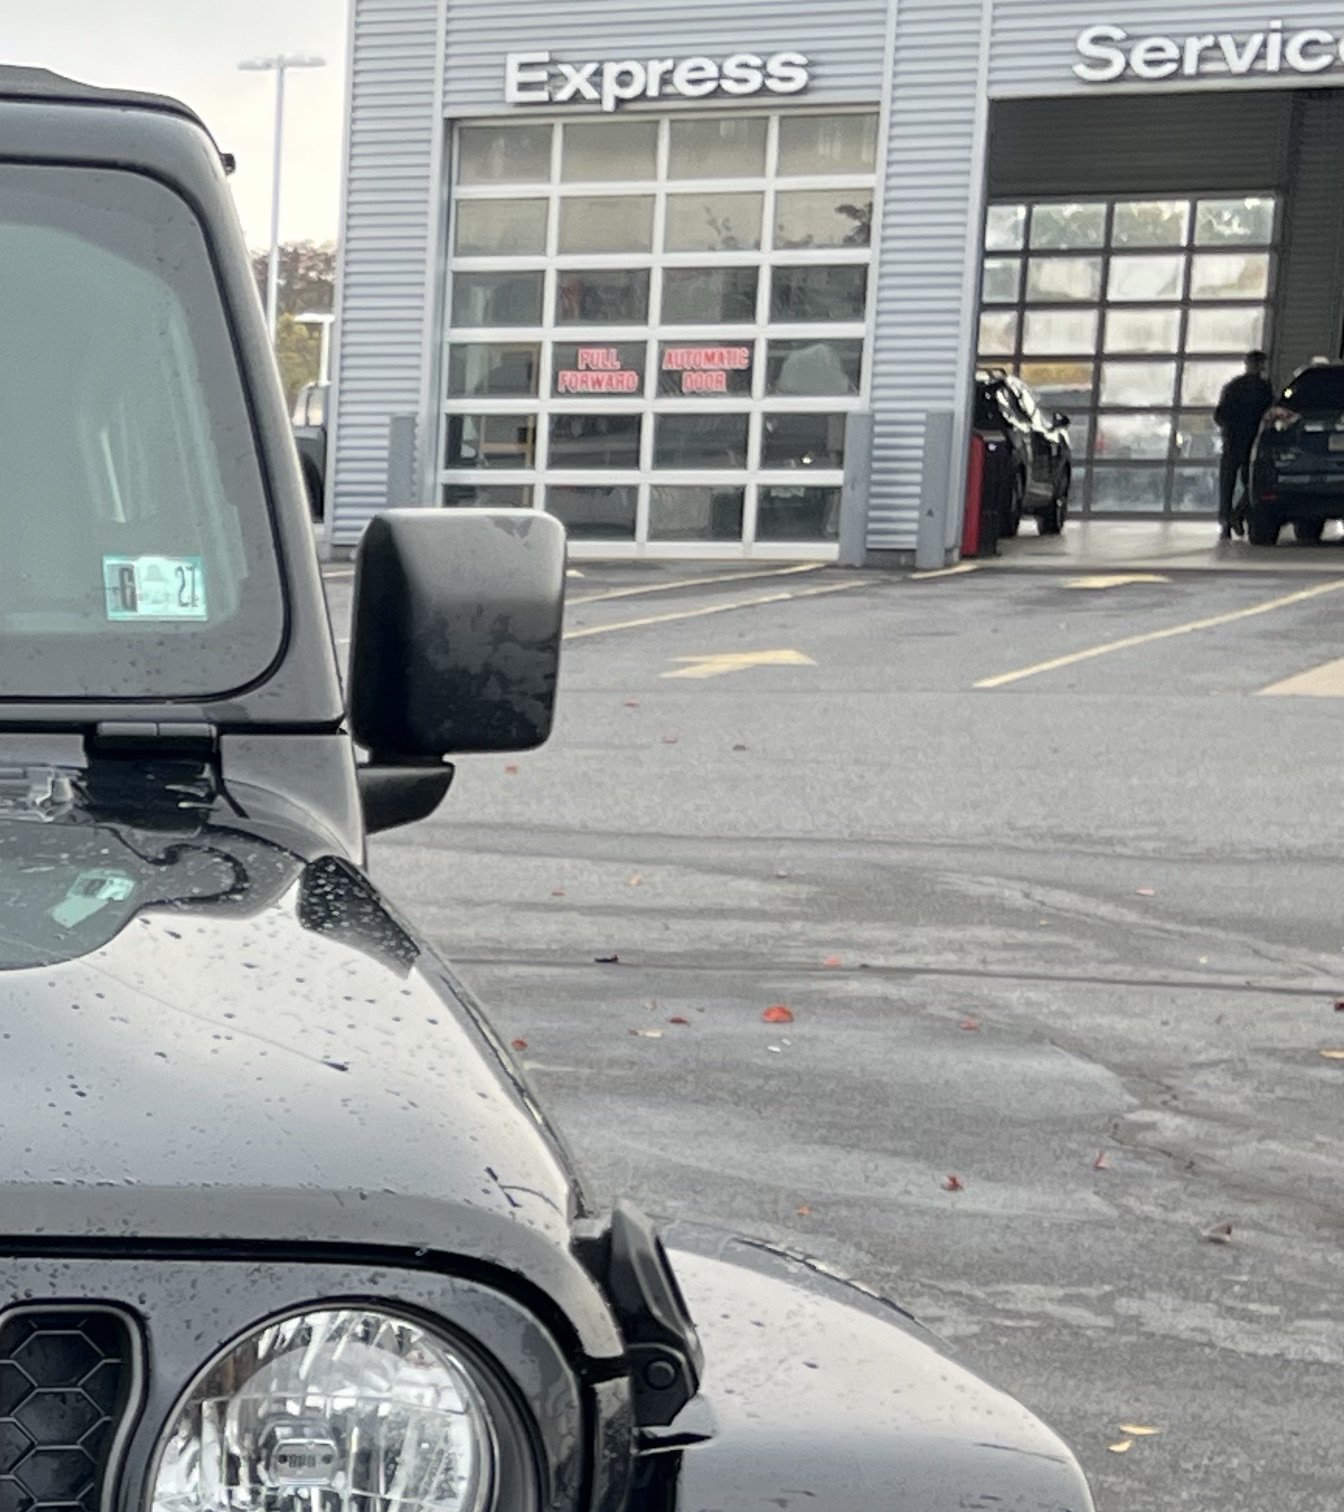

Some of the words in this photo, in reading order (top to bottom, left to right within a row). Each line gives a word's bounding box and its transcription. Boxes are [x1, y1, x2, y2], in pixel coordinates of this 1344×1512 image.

[1072, 20, 1344, 82] Servic
[505, 51, 810, 112] Express
[578, 348, 621, 370] PULL
[662, 347, 750, 370] AUTOMATIC
[558, 371, 639, 393] FORWARD
[682, 371, 727, 393] DOOR
